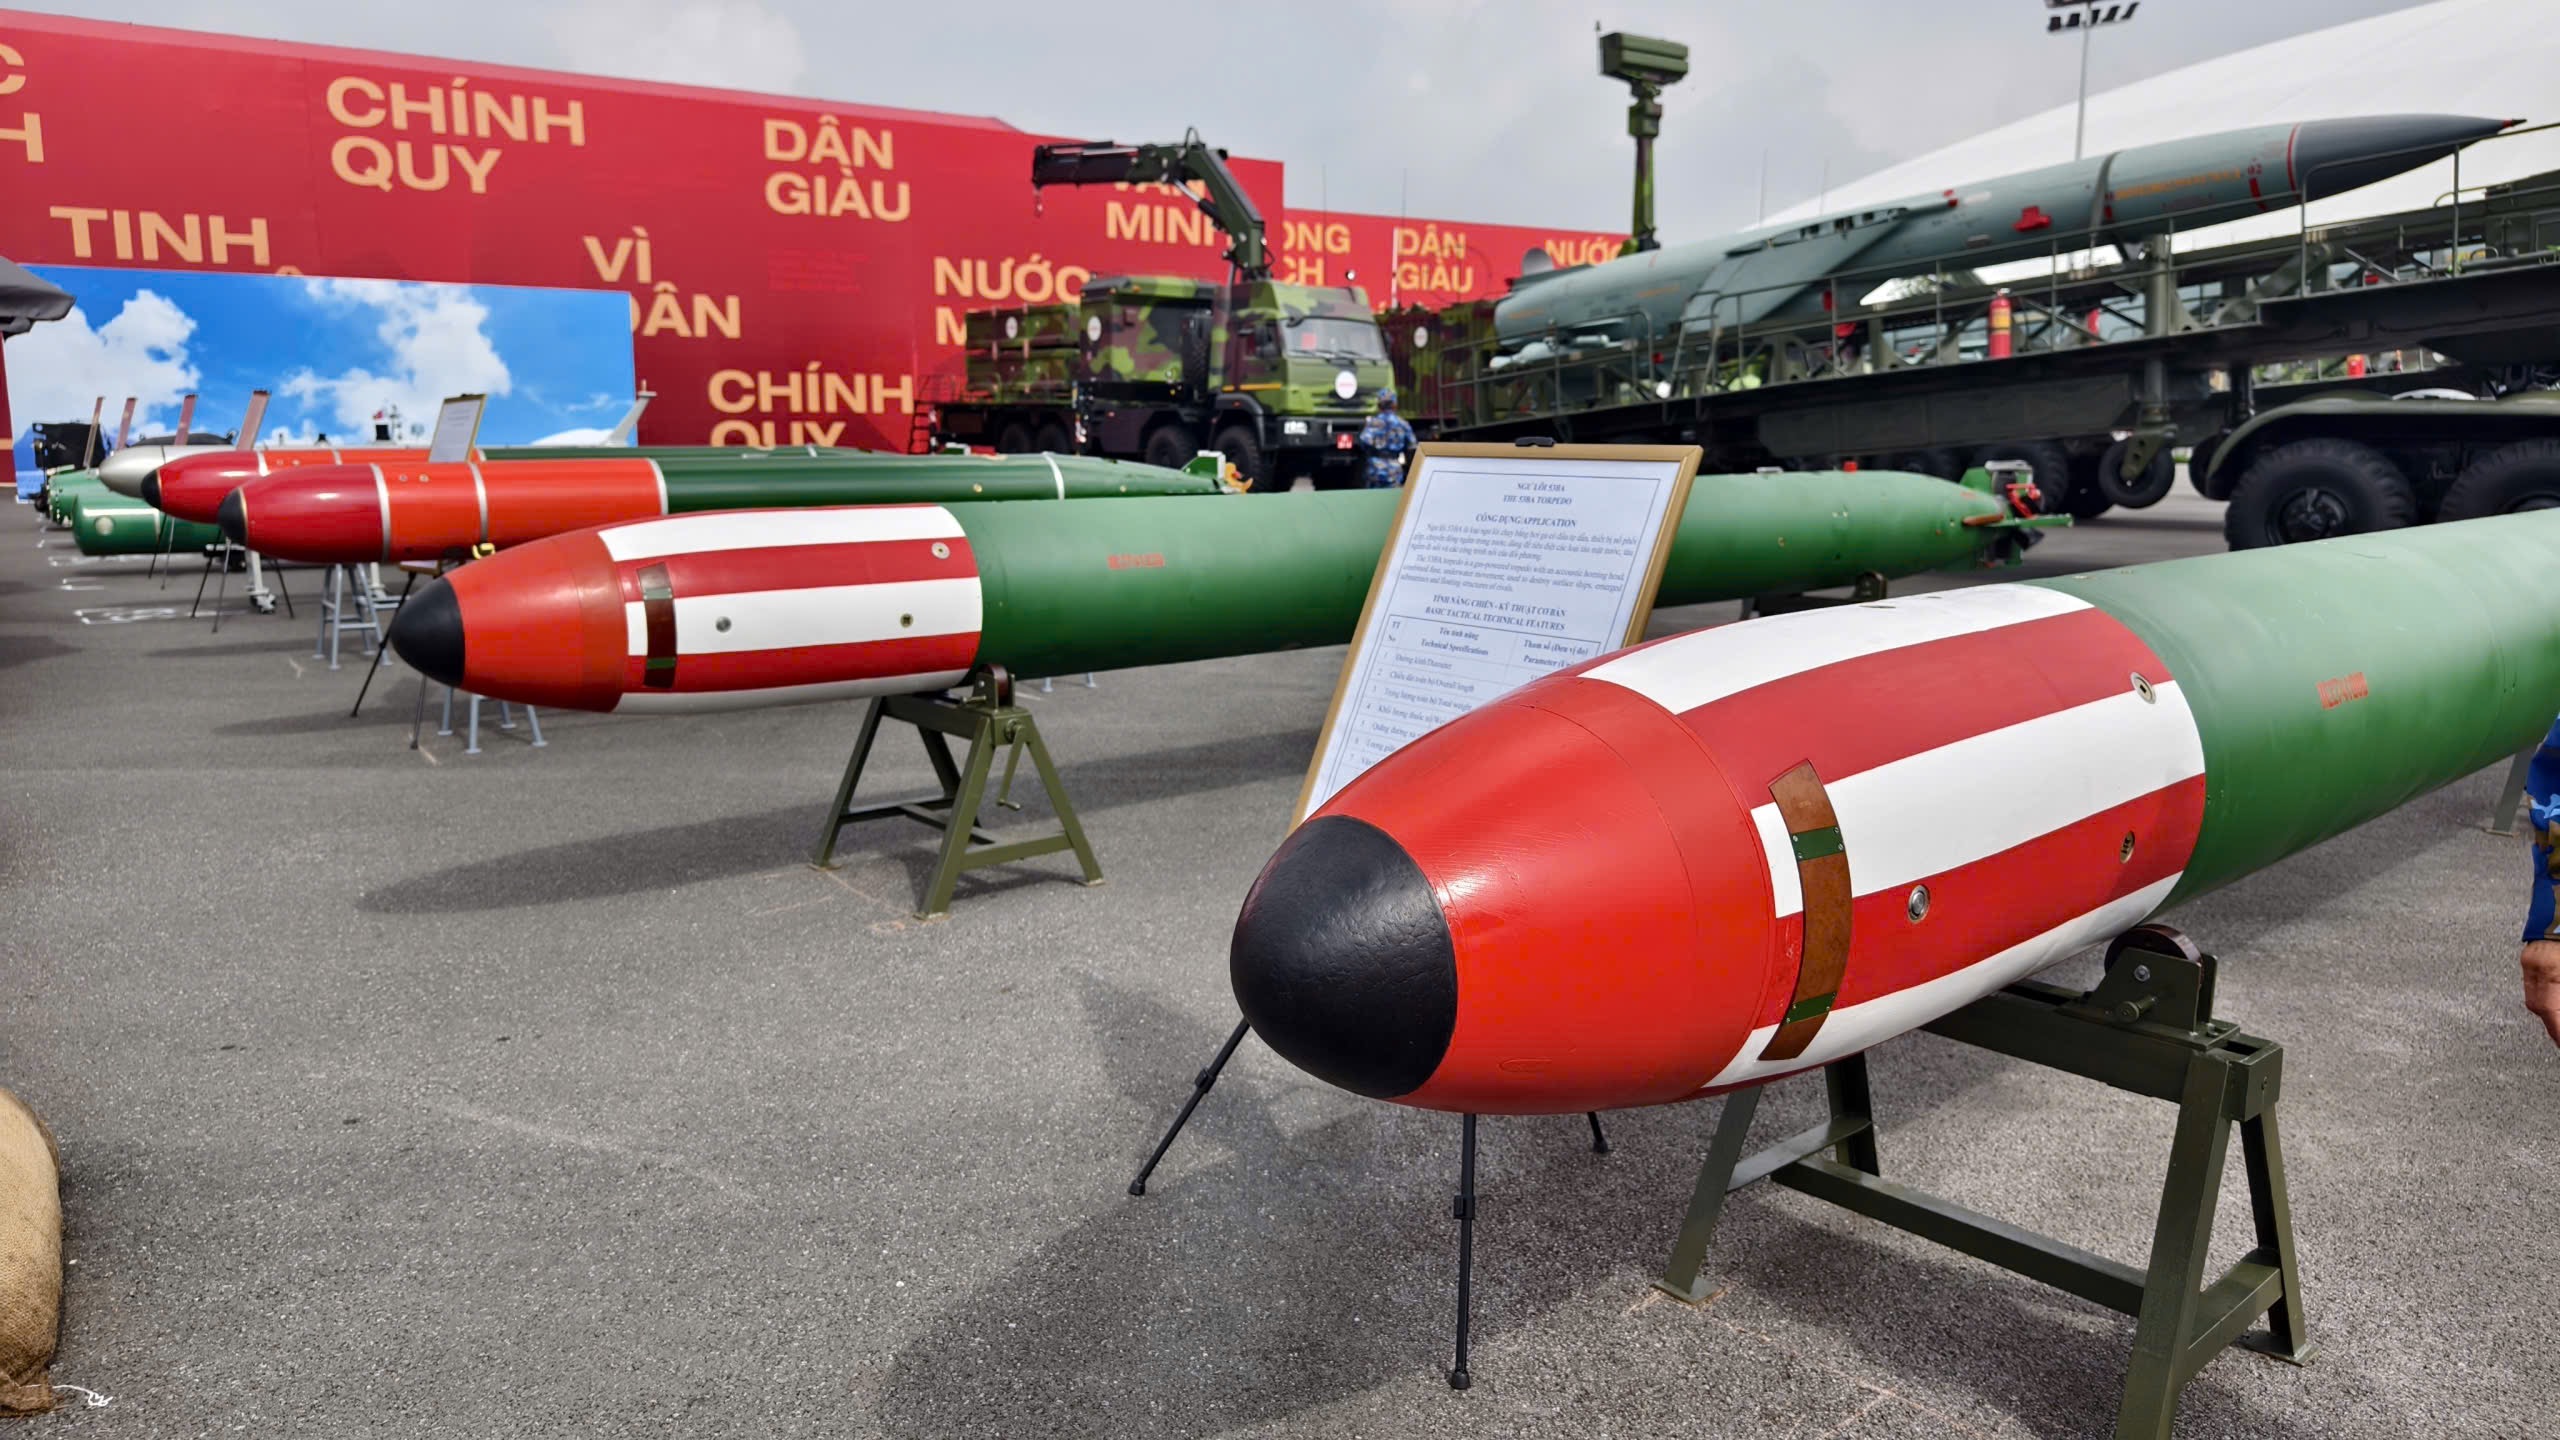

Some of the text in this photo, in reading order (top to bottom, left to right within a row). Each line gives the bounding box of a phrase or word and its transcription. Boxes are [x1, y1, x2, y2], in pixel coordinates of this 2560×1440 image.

[326, 76, 585, 146] CHÍNH
[331, 136, 502, 193] QUY
[764, 114, 893, 170] DÂN
[765, 167, 910, 222] GIÀU
[50, 206, 270, 266] TINH
[583, 225, 652, 284] VÌ
[1397, 224, 1466, 260] DÂN
[933, 253, 1090, 304] NƯỚC
[1396, 258, 1473, 293] GIÀU
[631, 281, 741, 338] ÂN
[708, 361, 914, 414] CHÍNH
[1536, 496, 1572, 504] TORPEDO
[1425, 606, 1565, 631] BASIC TACTICAL TECHNICAL FEATURES
[1421, 638, 1488, 657] Technical Specifications
